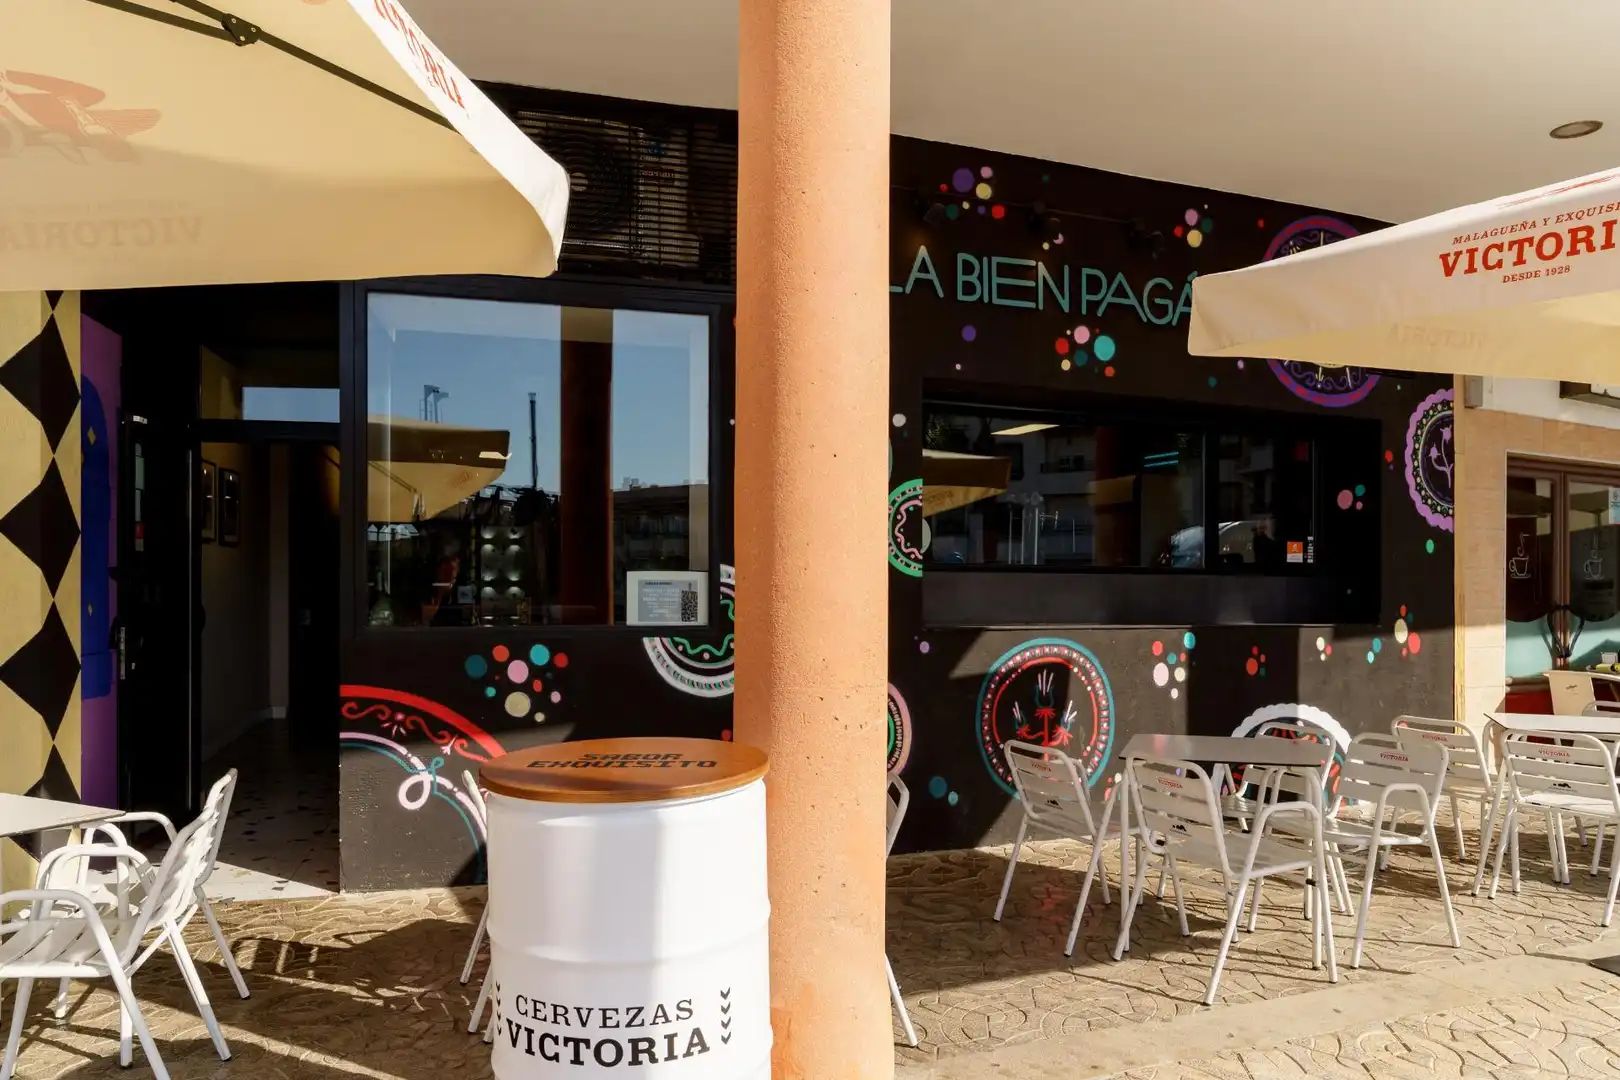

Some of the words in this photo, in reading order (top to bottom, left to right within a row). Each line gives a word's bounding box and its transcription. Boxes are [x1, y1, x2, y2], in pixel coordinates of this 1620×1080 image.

[1452, 220, 1537, 245] MALAGUEÑA
[1542, 217, 1552, 226] Y
[1439, 219, 1618, 277] VICTORI
[957, 252, 1070, 313] BIEN
[1502, 270, 1541, 283] DESDE
[1545, 265, 1571, 277] 1928
[527, 760, 718, 768] EXQUISITO
[579, 753, 683, 761] SABOR
[515, 994, 694, 1029] CERVEZAS
[506, 1027, 711, 1068] VICTORIA
